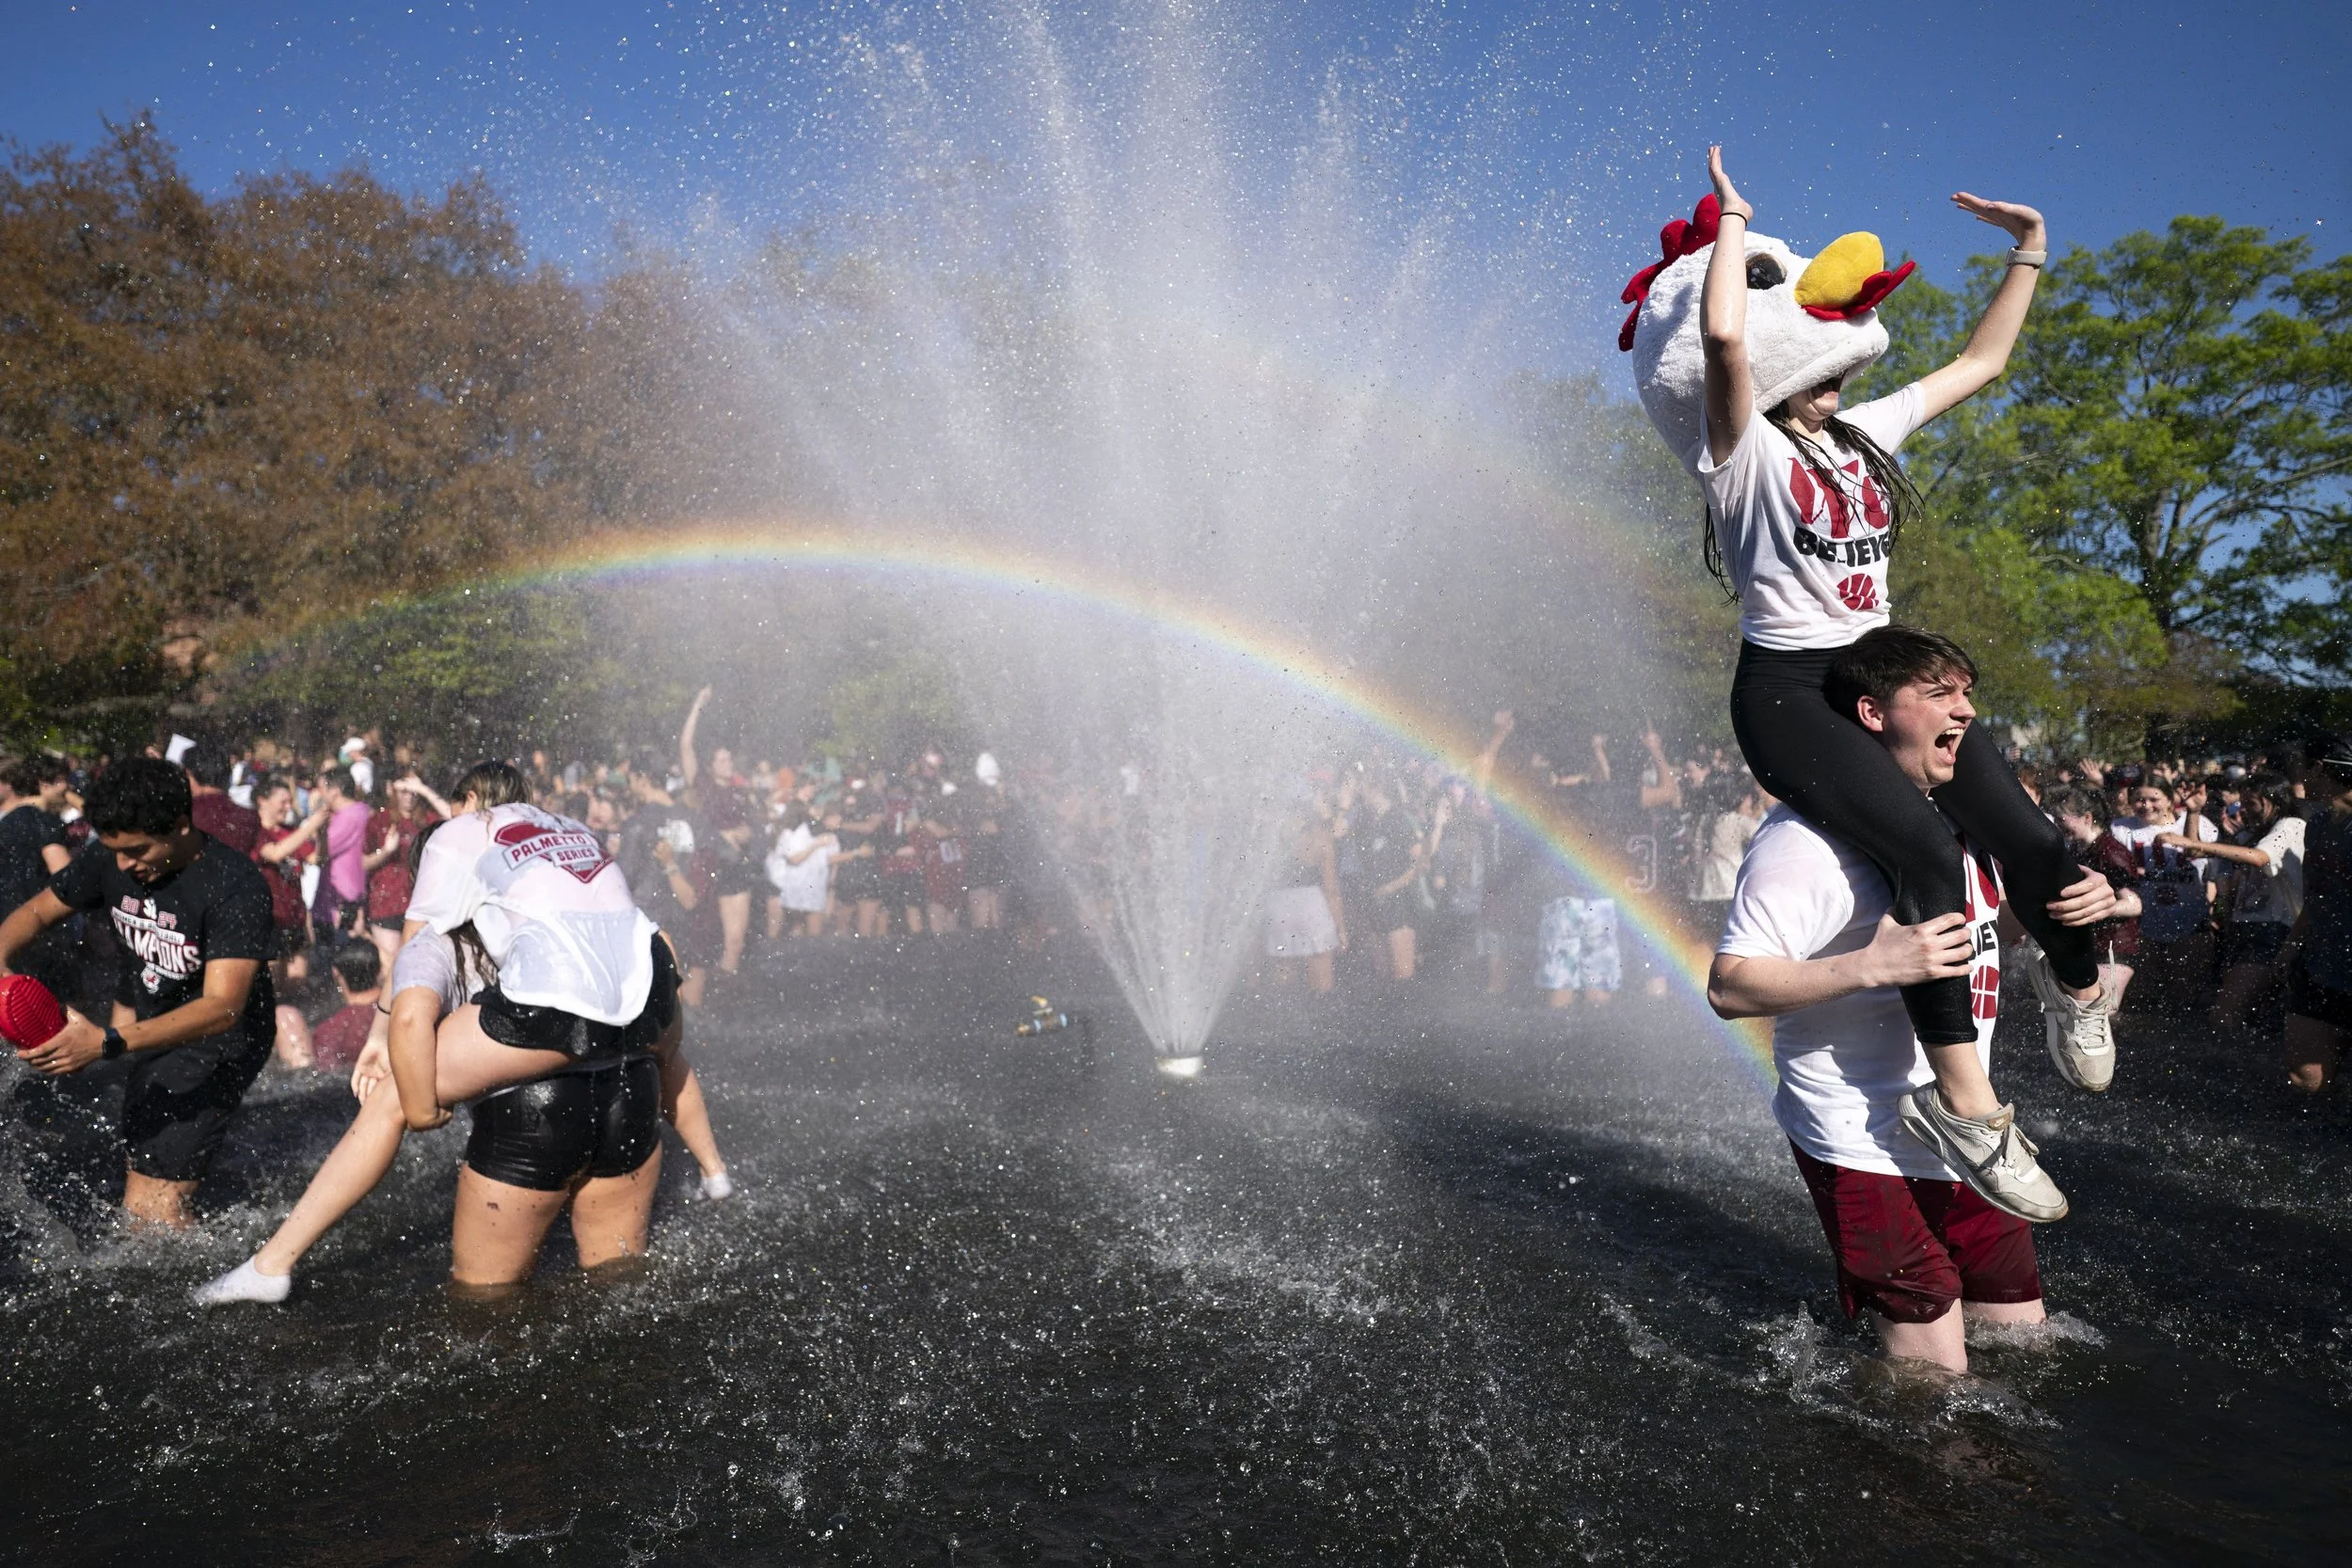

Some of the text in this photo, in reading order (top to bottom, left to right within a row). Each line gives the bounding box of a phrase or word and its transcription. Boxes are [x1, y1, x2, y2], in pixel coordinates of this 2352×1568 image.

[511, 834, 586, 862] PALMETTO
[556, 848, 595, 862] SERIES
[113, 919, 201, 974] AMPIONS
